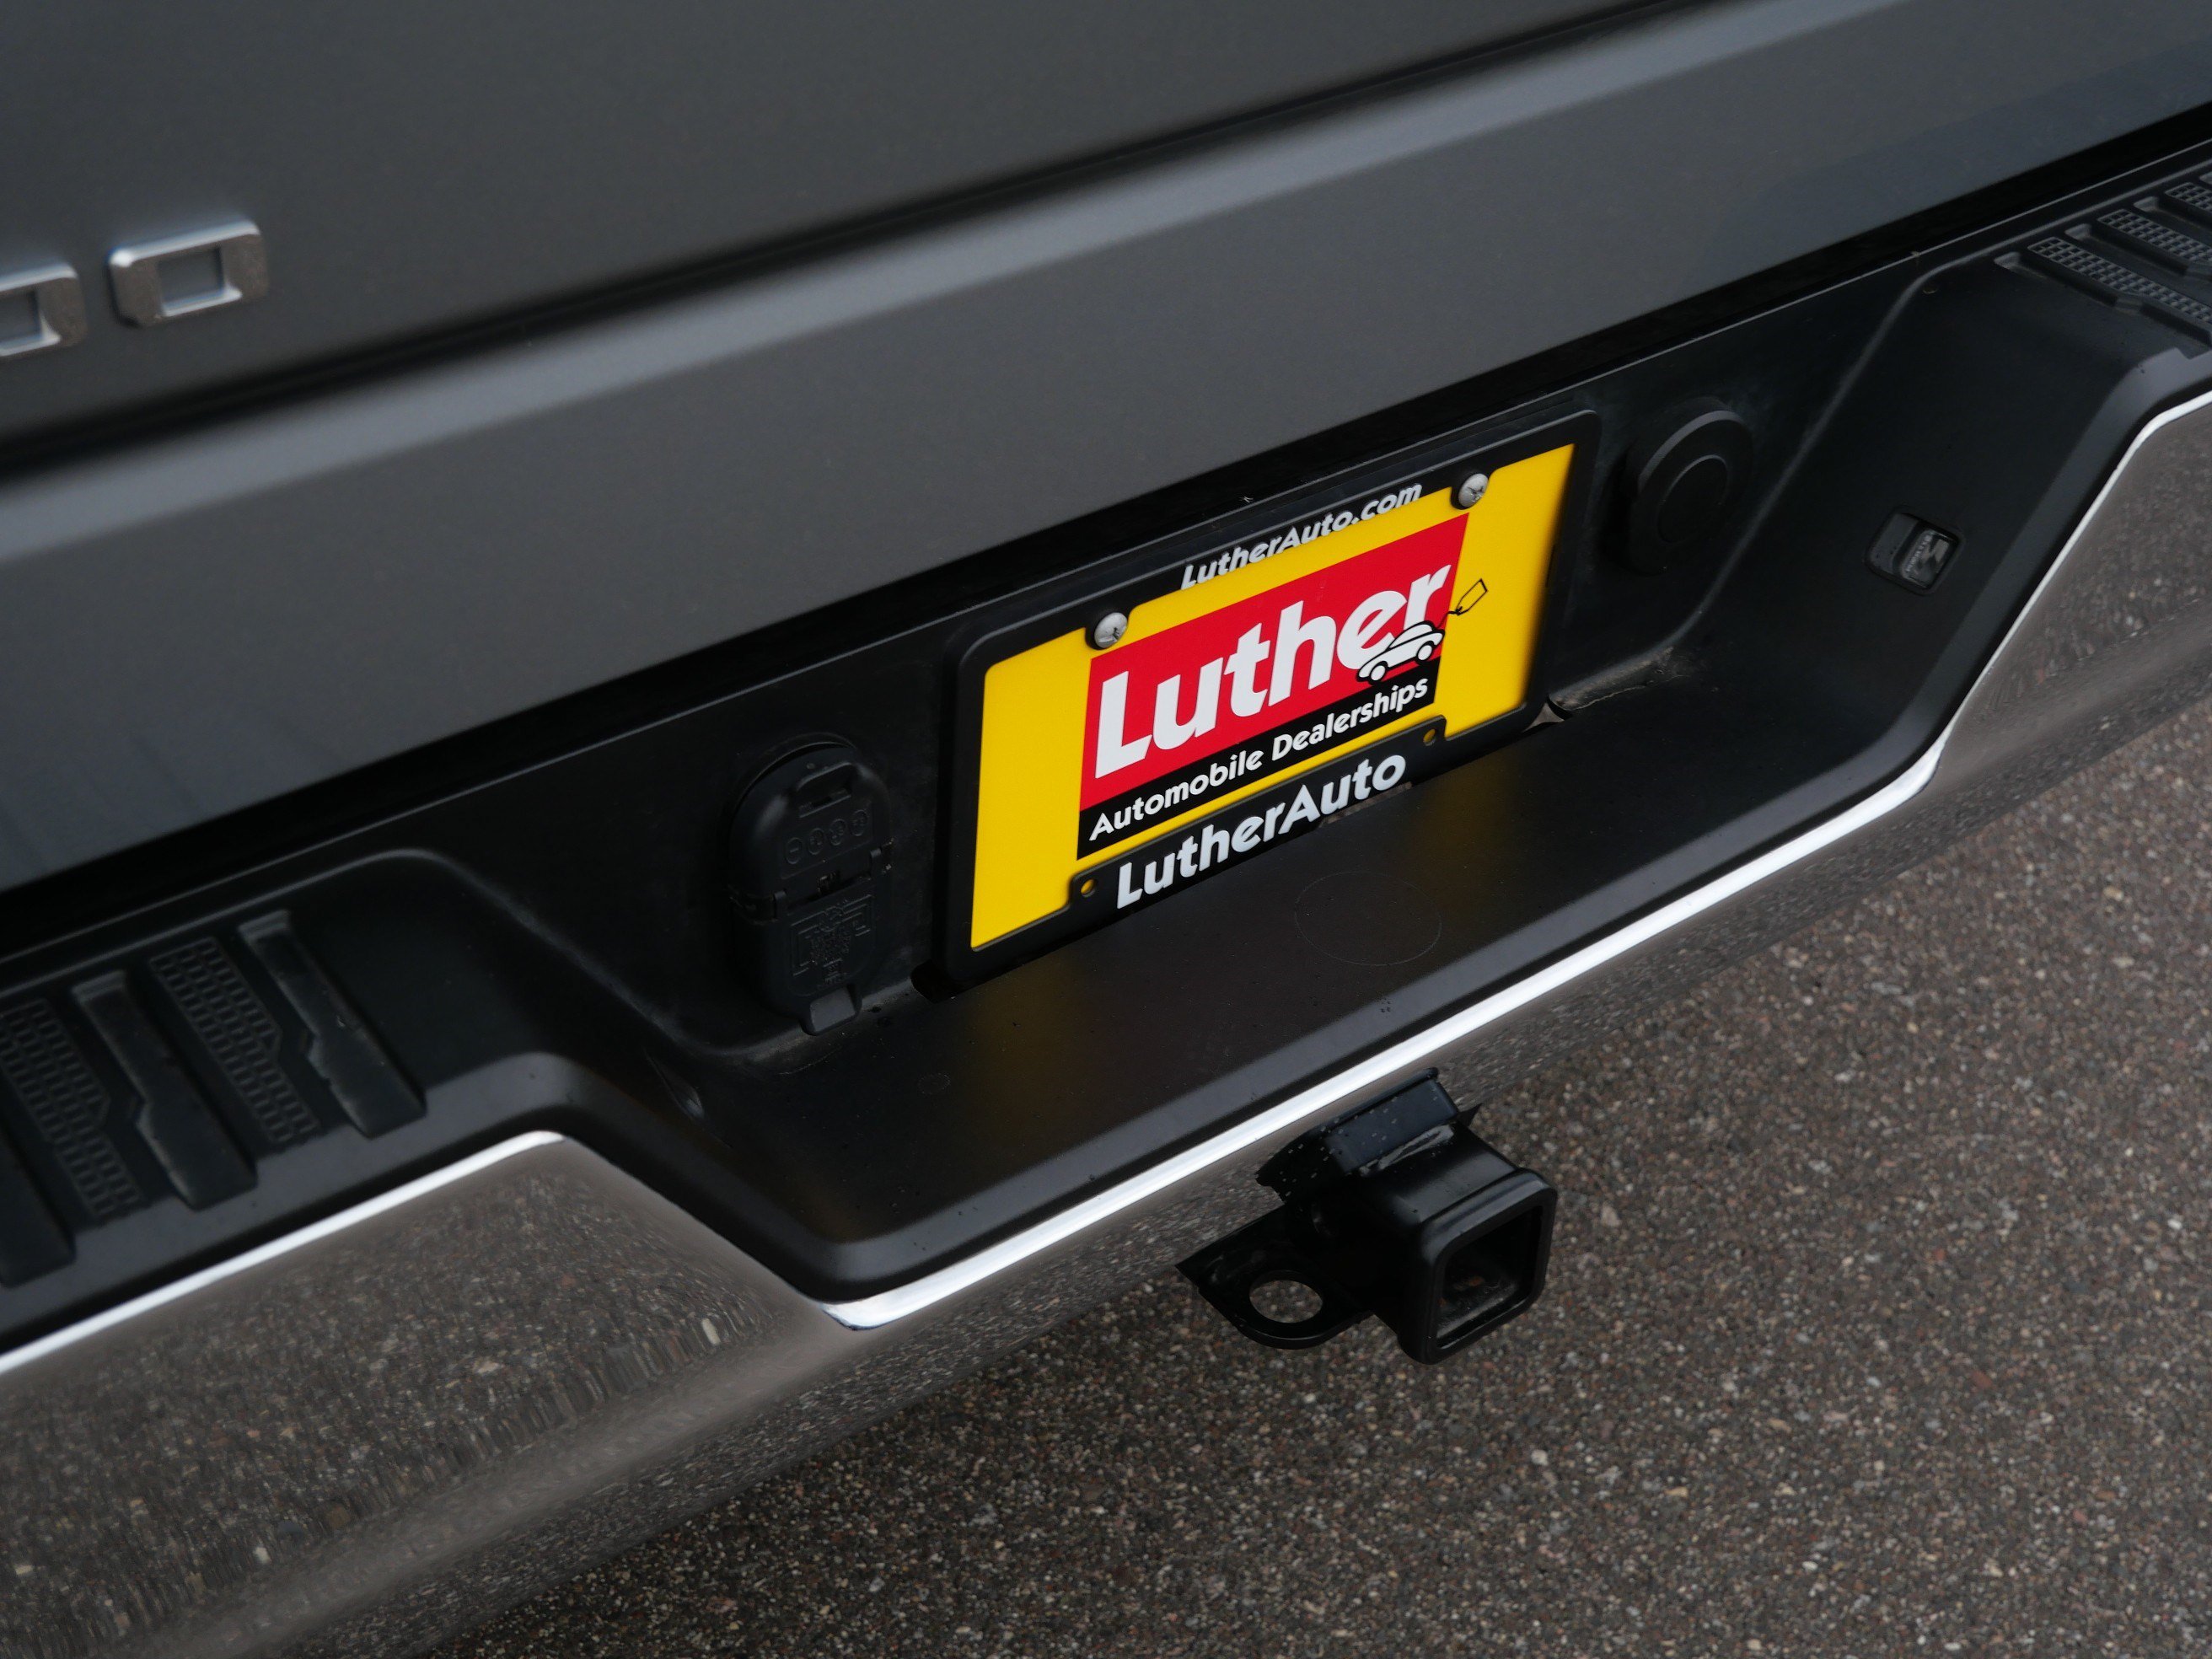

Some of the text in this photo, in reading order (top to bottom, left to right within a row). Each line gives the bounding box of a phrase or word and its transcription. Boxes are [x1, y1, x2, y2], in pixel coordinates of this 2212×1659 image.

[1181, 482, 1423, 590] LutherAuto.com
[1095, 564, 1452, 778] Luther
[1089, 679, 1428, 841] Automobile Dealerships
[1116, 754, 1406, 910] LutherAuto
